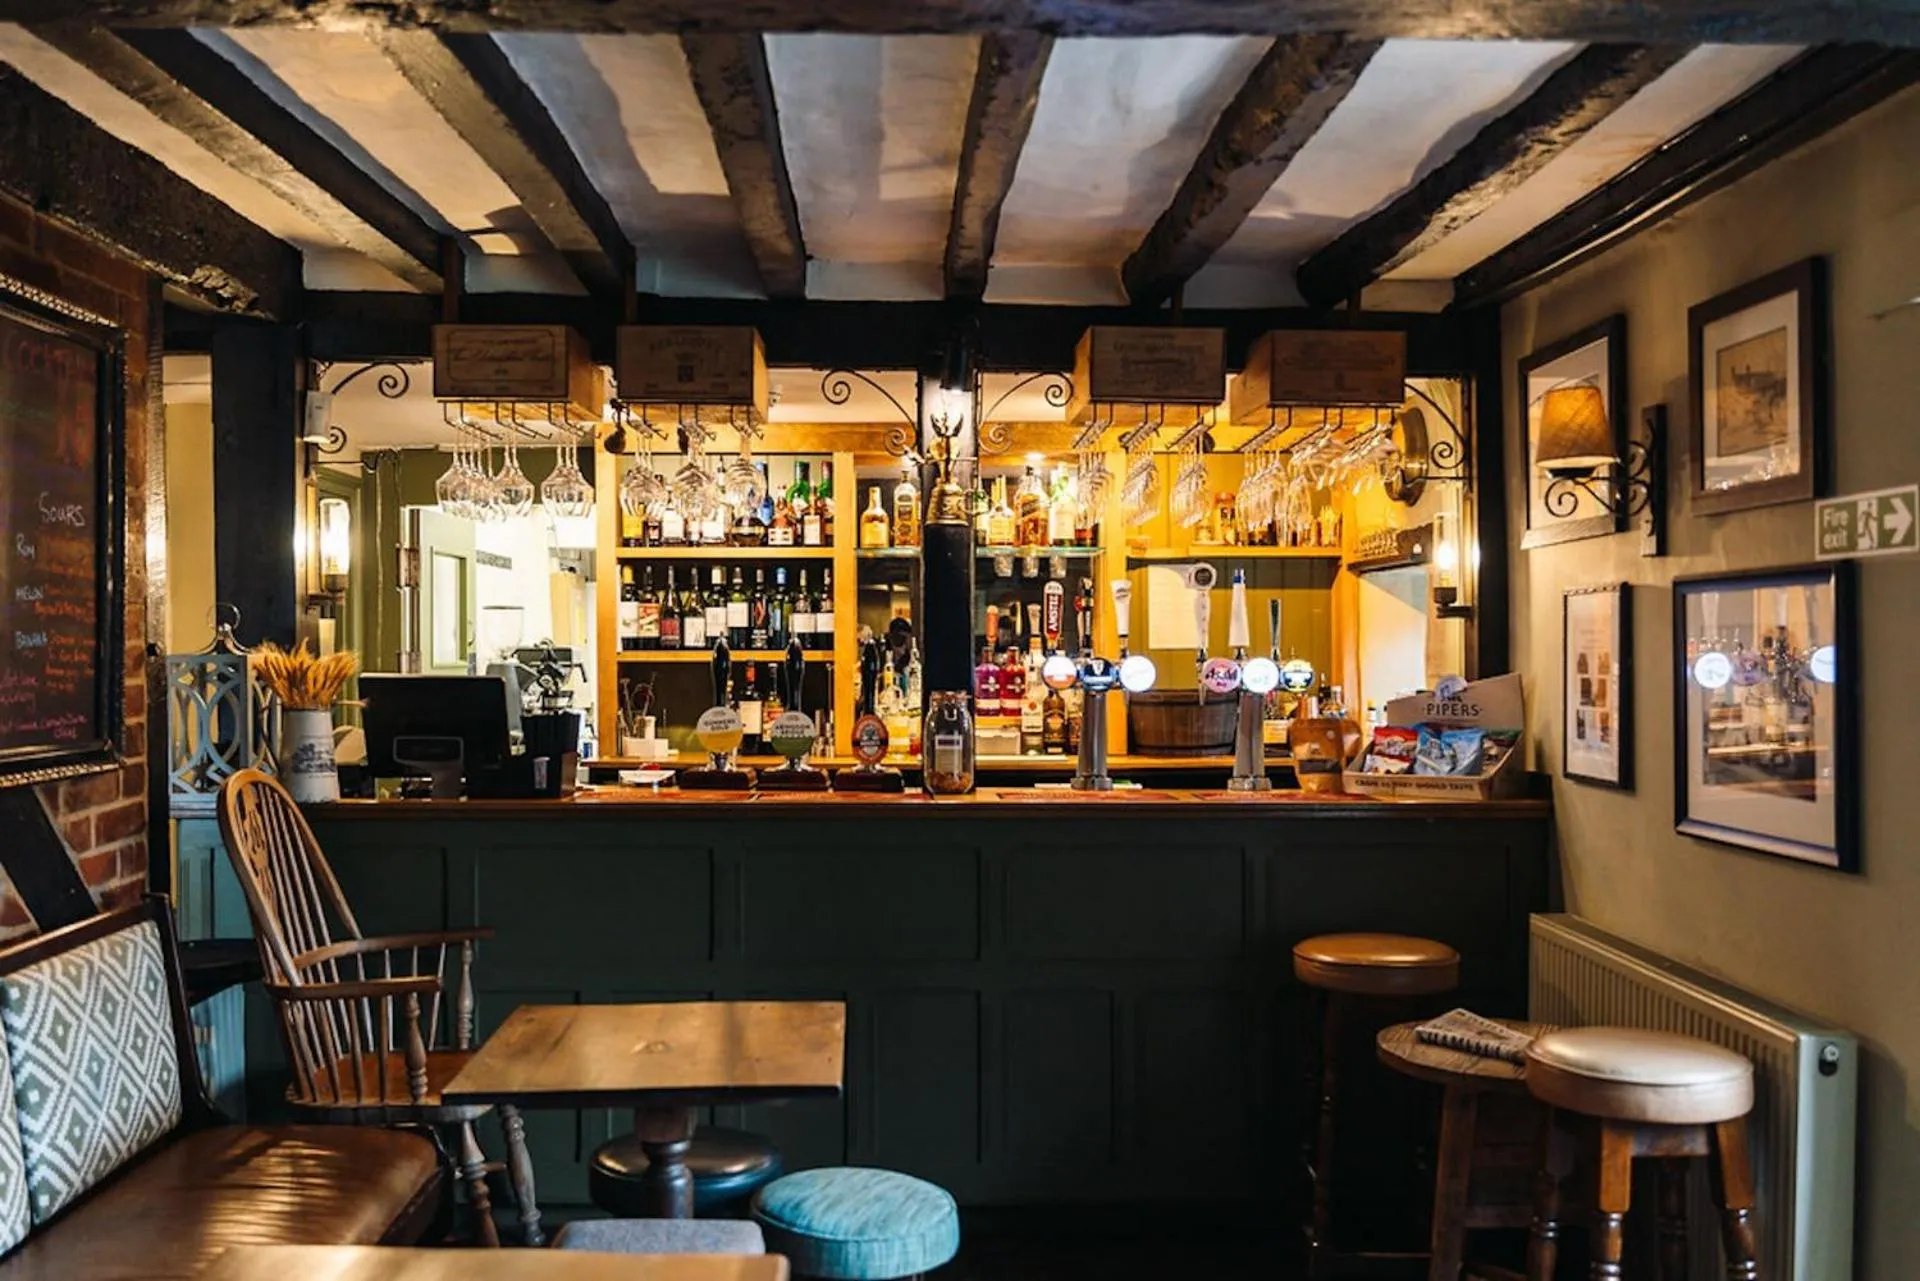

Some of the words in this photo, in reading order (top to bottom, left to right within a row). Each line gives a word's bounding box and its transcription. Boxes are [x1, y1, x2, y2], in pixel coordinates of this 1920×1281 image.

[1823, 507, 1850, 528] Fire
[1823, 529, 1848, 550] exit
[1047, 595, 1059, 632] AMSTEL
[1426, 702, 1480, 717] PIPERS
